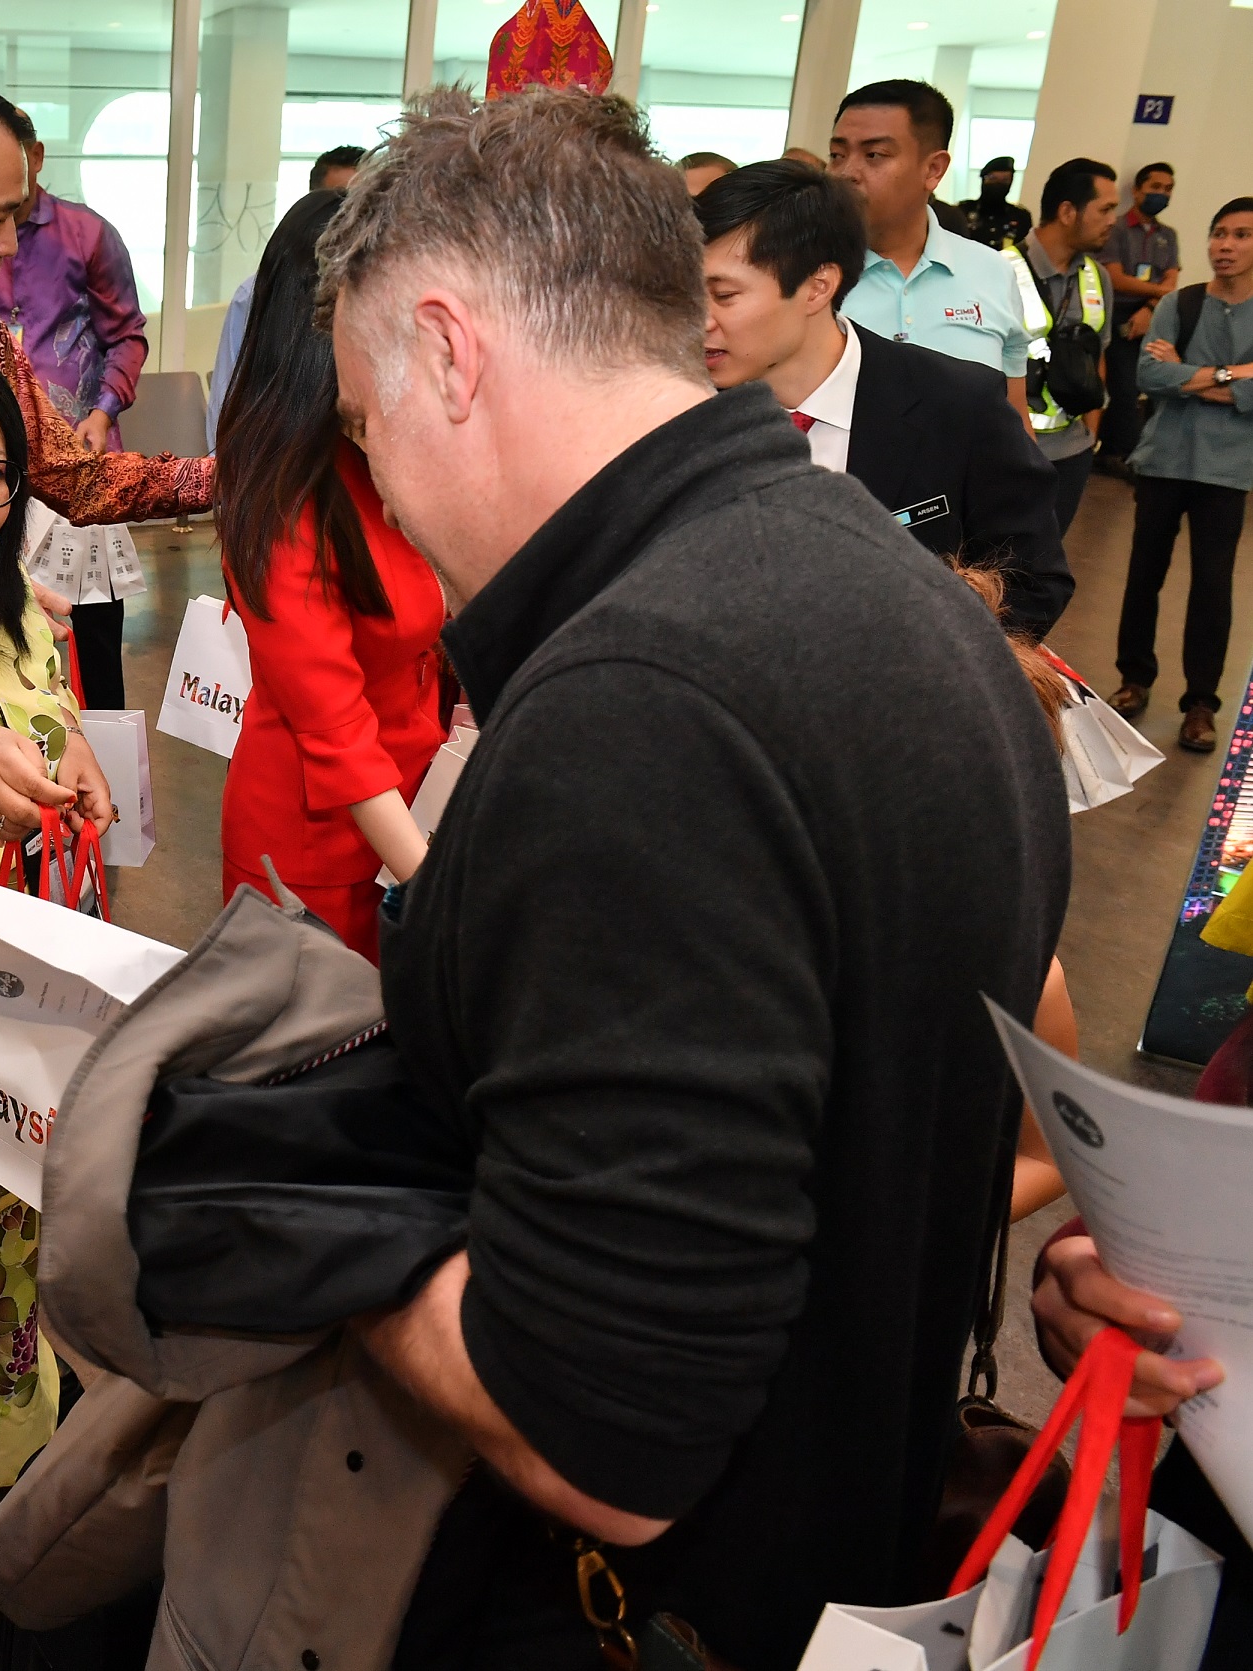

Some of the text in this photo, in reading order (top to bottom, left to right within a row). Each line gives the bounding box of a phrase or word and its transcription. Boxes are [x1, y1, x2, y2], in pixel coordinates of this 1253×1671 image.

[1142, 99, 1164, 120] P3
[917, 504, 940, 517] ARSEN
[179, 671, 245, 724] Malay
